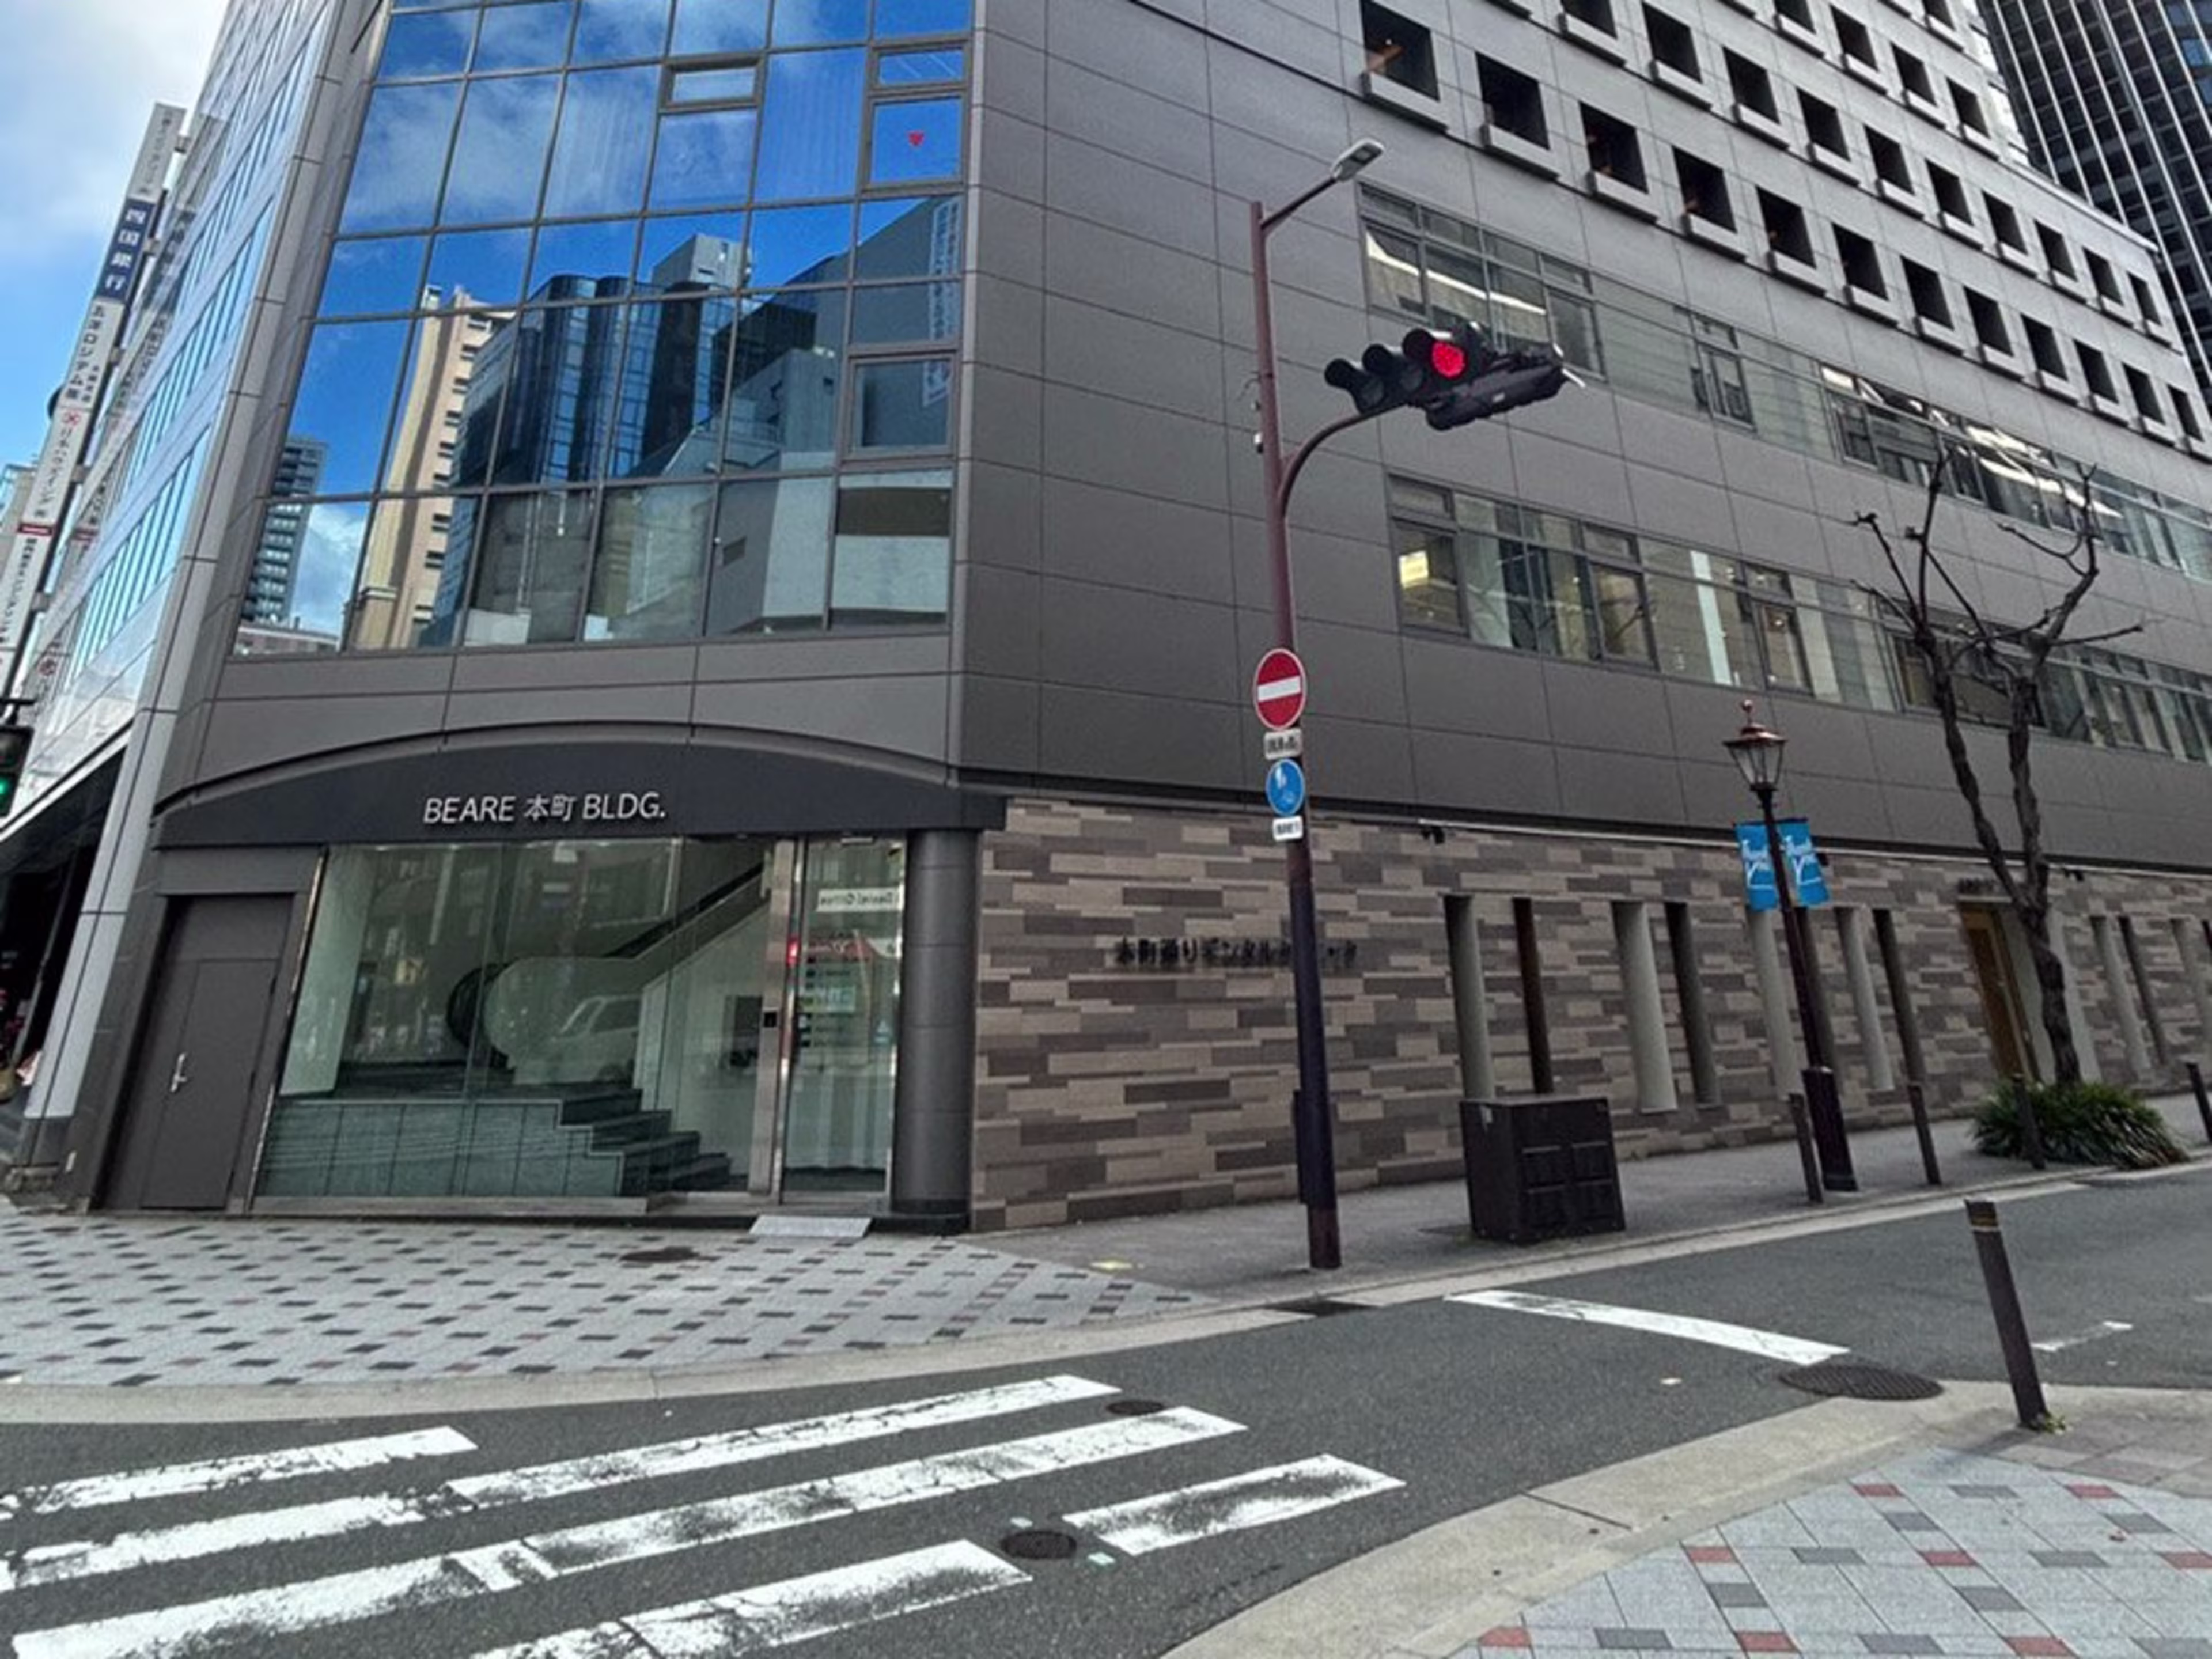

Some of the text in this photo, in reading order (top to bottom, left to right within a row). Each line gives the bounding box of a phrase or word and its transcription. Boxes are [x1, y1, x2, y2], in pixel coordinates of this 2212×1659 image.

[423, 791, 666, 824] BEARE 本町 BLDG.
